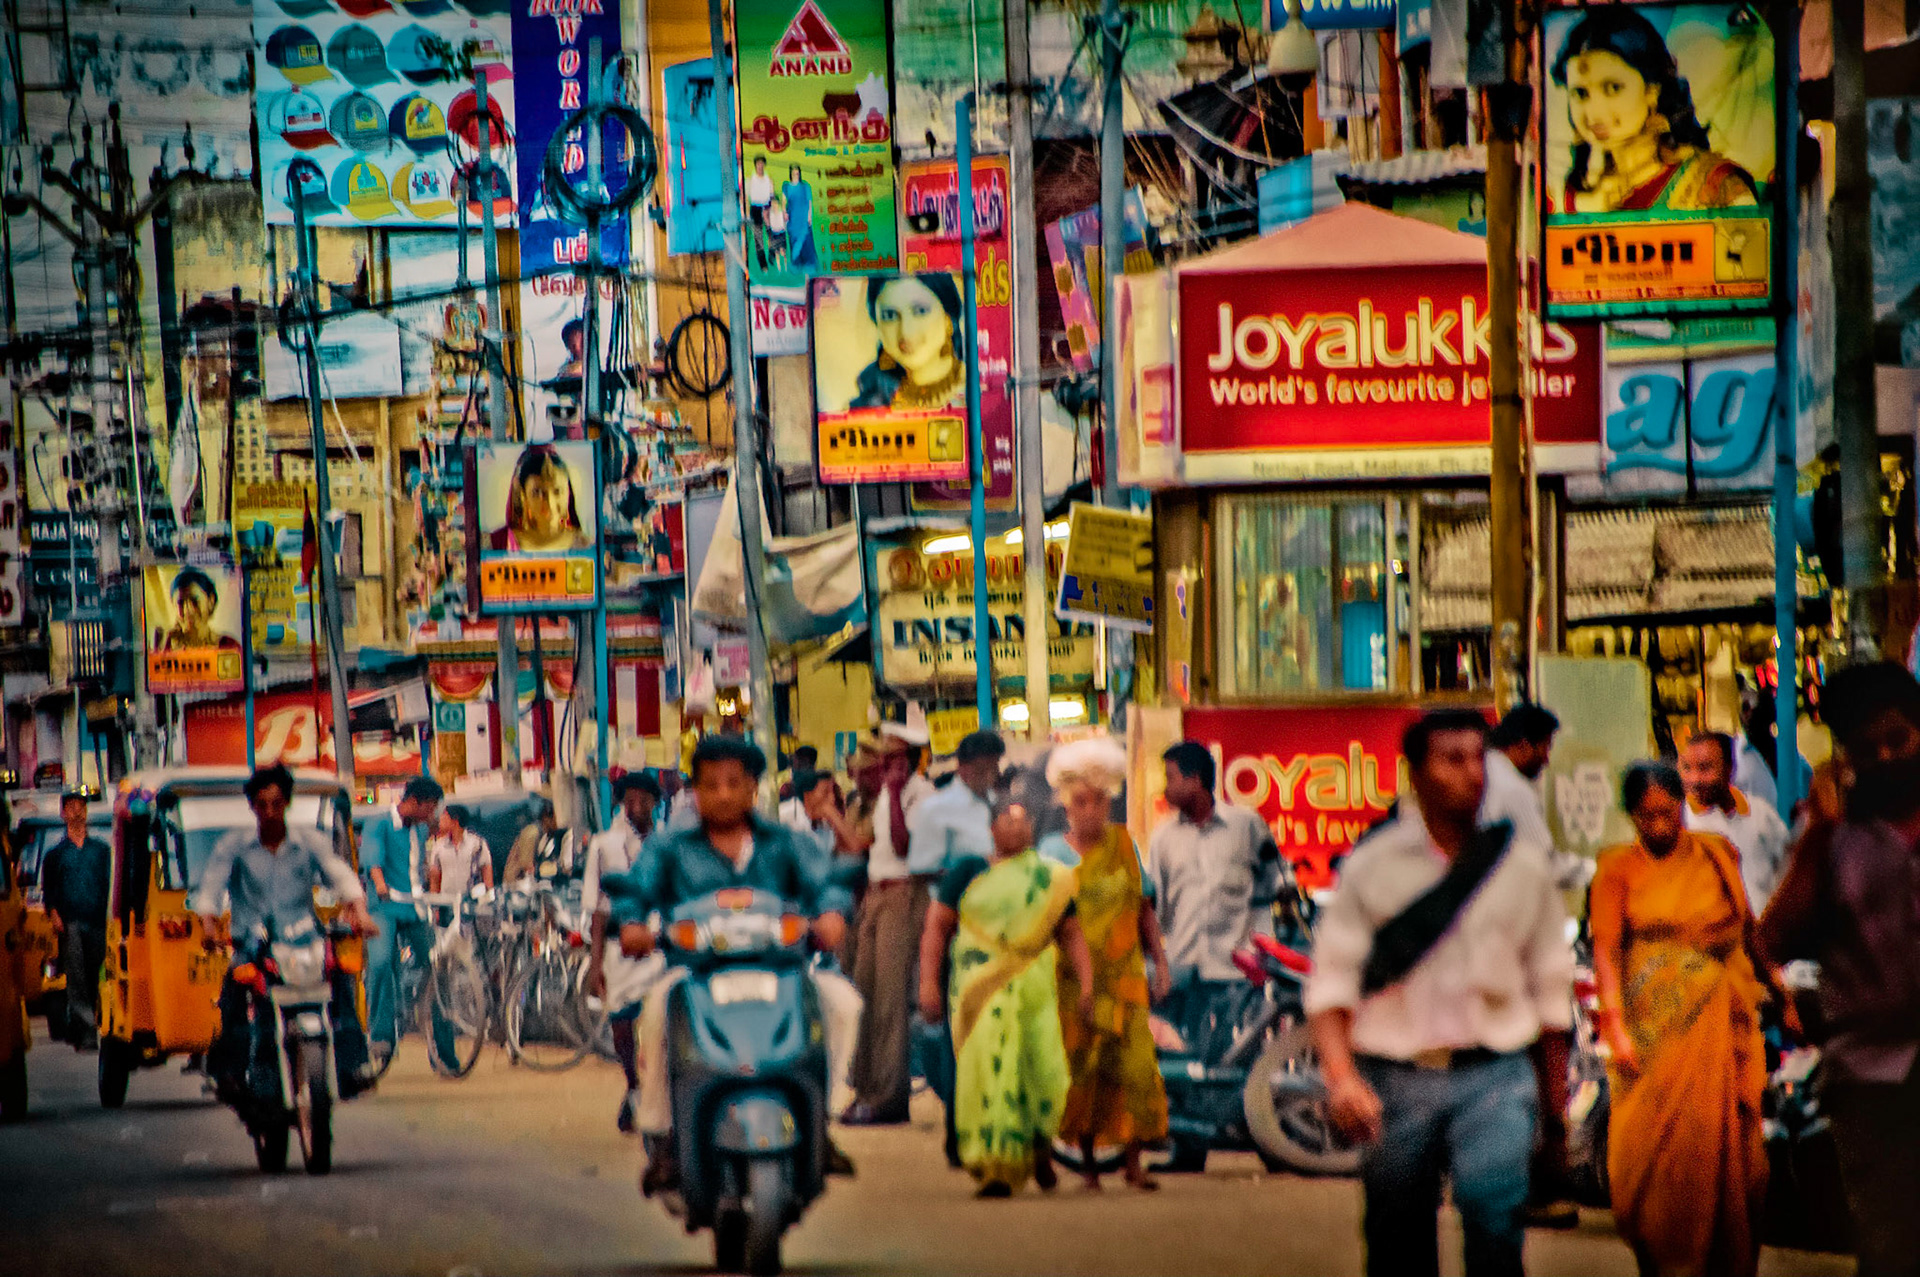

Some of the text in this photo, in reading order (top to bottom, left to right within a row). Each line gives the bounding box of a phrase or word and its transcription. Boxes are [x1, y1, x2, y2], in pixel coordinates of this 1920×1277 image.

[769, 57, 852, 77] ANAND
[1208, 295, 1578, 371] Joyalukks
[1210, 374, 1317, 406] World's
[1326, 371, 1455, 403] favourite
